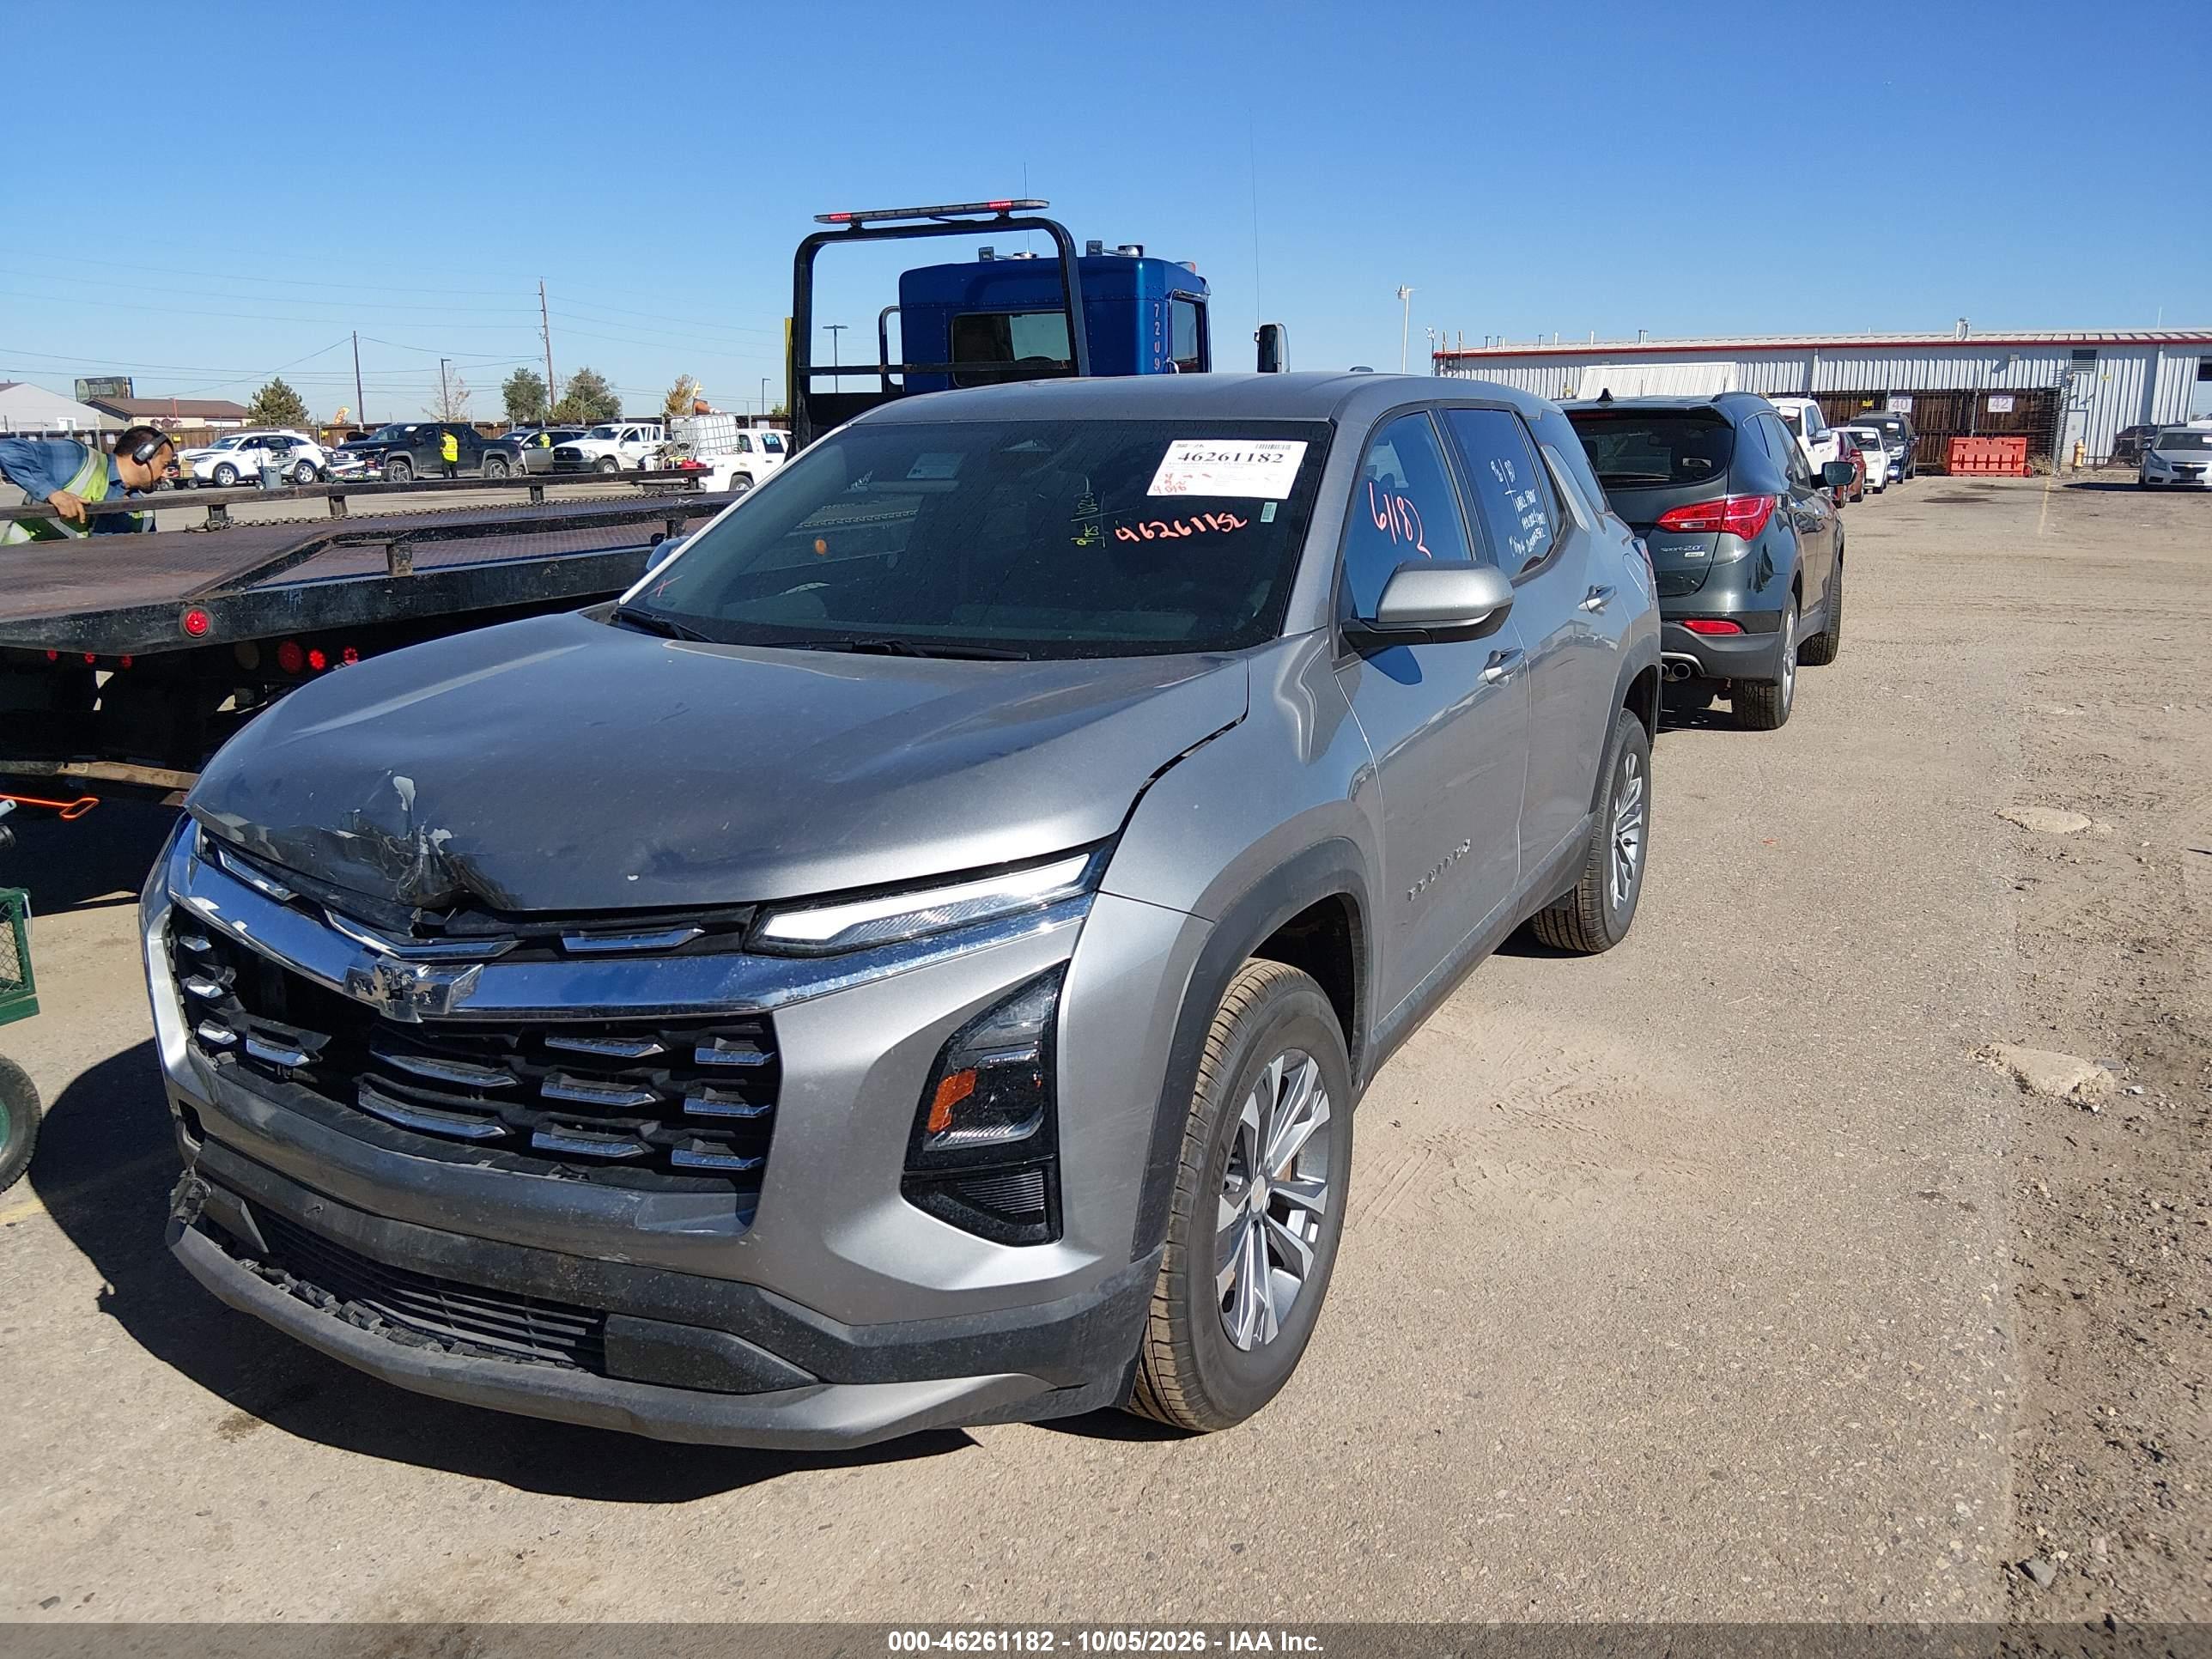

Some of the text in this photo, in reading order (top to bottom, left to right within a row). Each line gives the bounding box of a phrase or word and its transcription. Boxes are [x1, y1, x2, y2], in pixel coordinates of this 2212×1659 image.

[1891, 398, 1909, 410] 40
[1990, 398, 2010, 410] 42
[1177, 452, 1284, 464] 46261182
